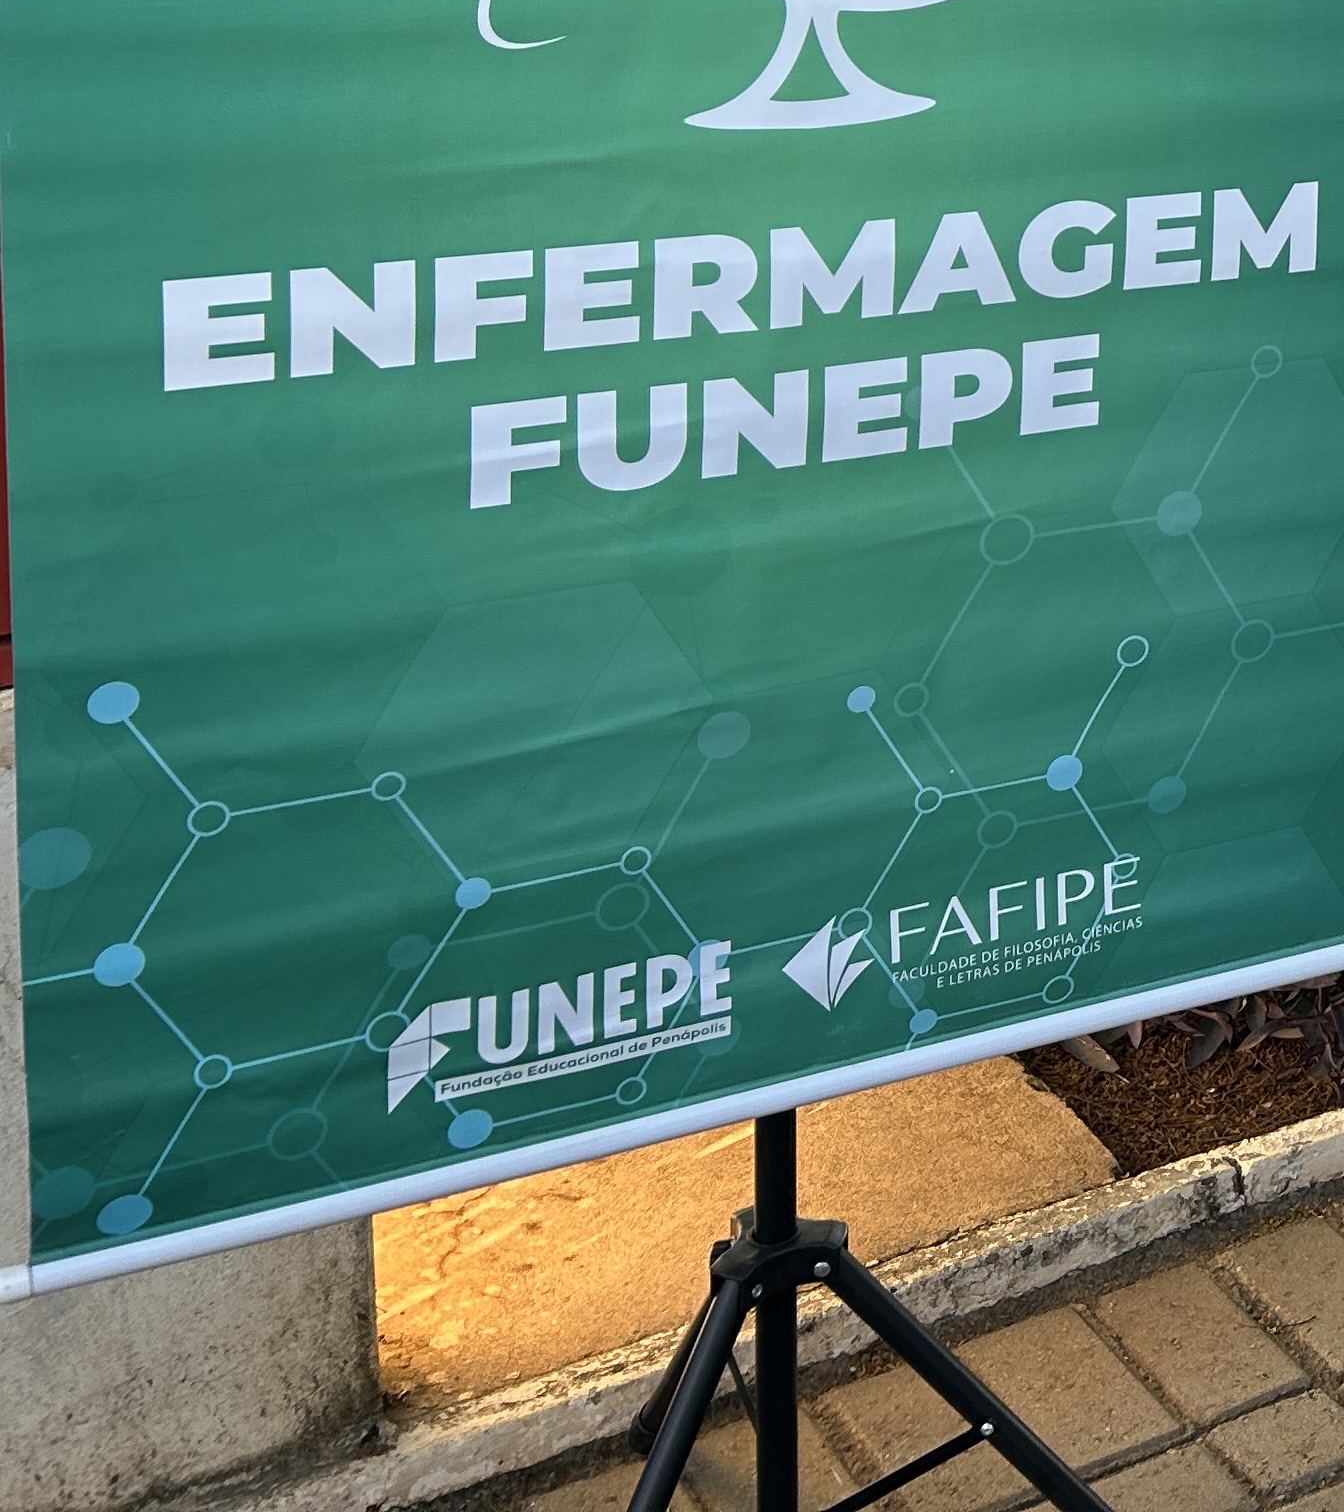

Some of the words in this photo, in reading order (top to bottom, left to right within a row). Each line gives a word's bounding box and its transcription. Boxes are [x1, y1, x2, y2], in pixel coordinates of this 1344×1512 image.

[162, 181, 1320, 391] ENFERMAGEM
[469, 333, 1102, 510] FUNEPE
[889, 856, 1142, 964] FAFIPE
[892, 955, 977, 984] FACULDADE
[981, 949, 1000, 965] DE
[1004, 931, 1079, 958] FILOSOFIA,
[936, 976, 944, 989] E
[949, 963, 1000, 986] LETRAS
[1004, 959, 1023, 972] DE
[1026, 940, 1102, 968] PENÁPOLIS
[387, 940, 732, 1115] FUNEPE
[440, 1068, 523, 1095] Fundação
[527, 1044, 624, 1077] Educacional
[626, 1038, 648, 1054] de
[651, 1020, 727, 1049] Penápolis
